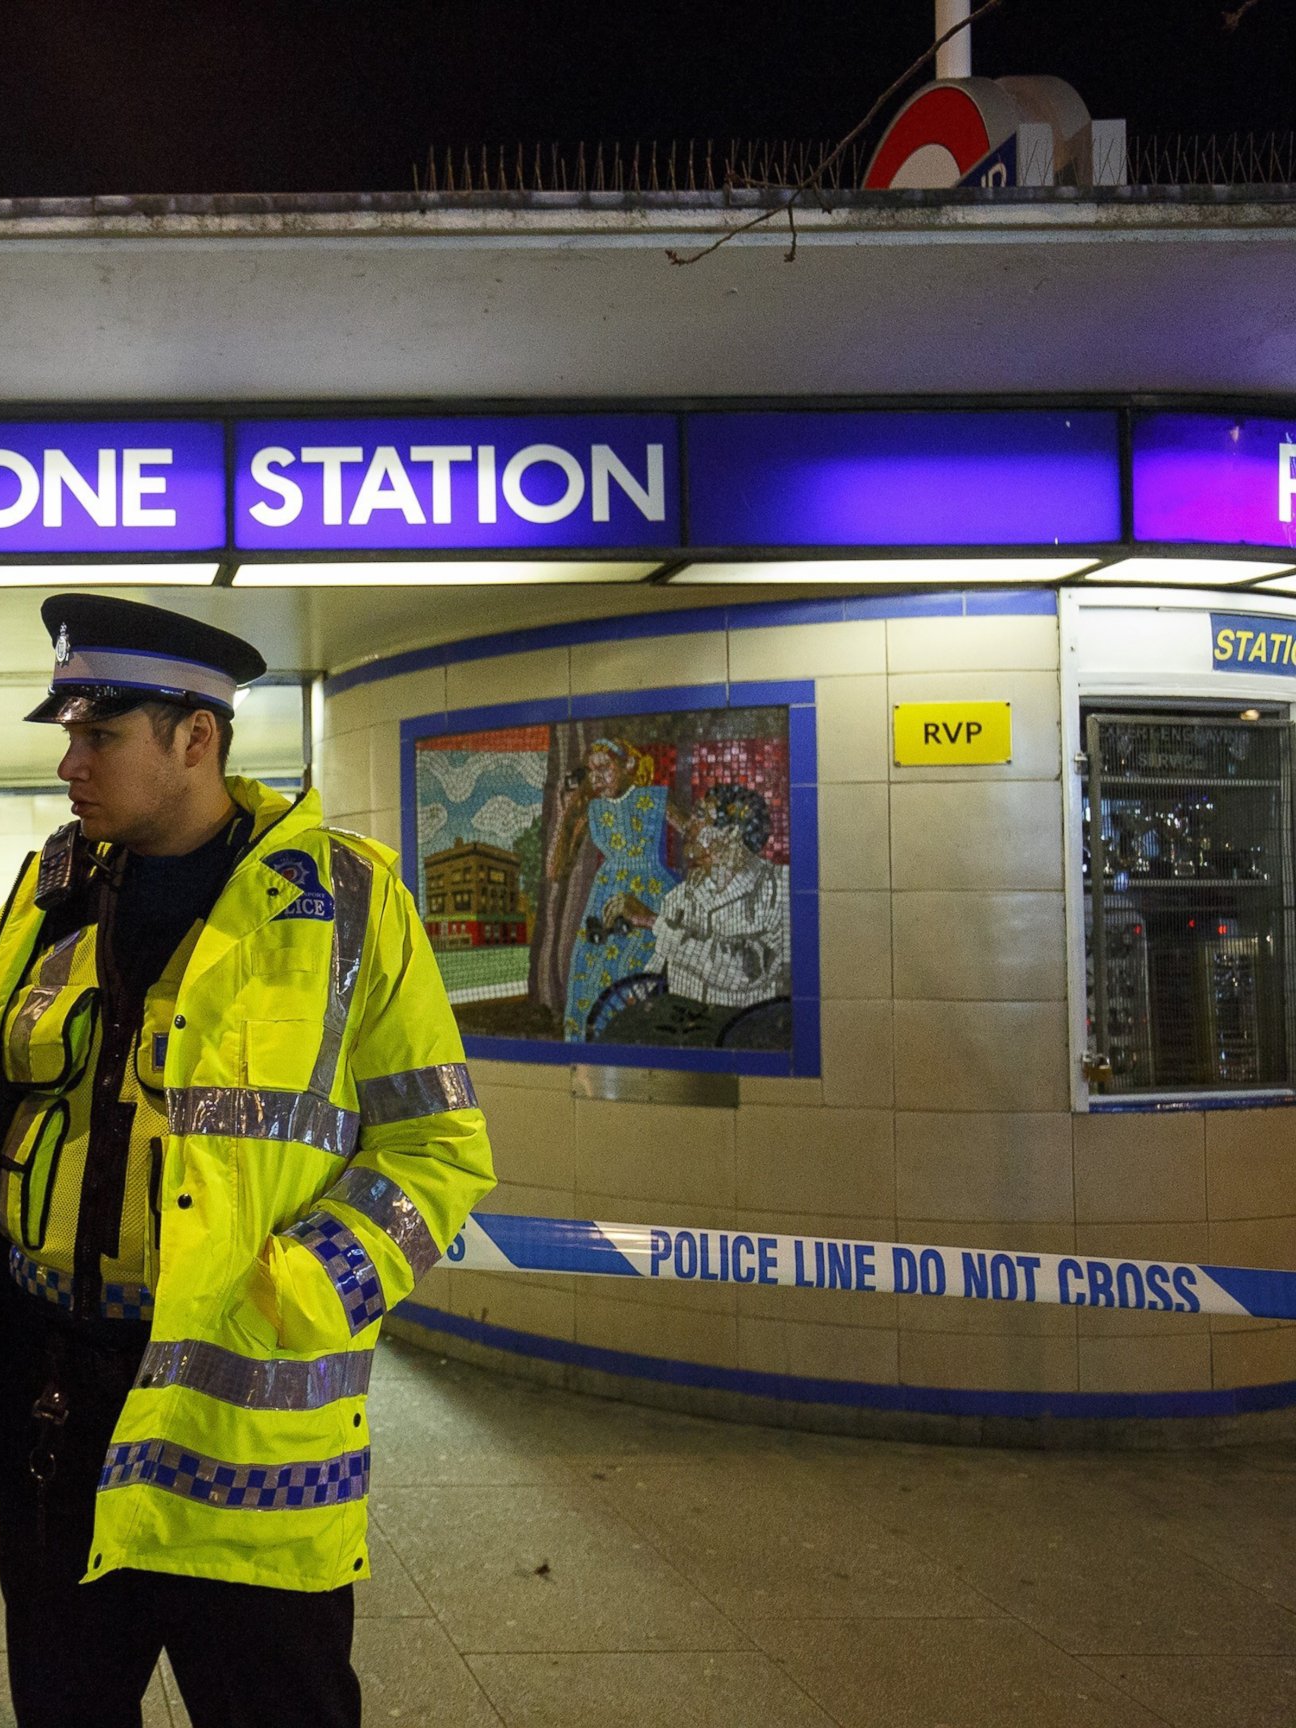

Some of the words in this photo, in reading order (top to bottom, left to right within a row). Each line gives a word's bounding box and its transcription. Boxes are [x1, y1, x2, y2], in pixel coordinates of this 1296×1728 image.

[248, 443, 665, 527] STATION
[1213, 627, 1296, 666] STATI
[923, 721, 983, 744] RVP
[284, 898, 326, 916] LICE
[650, 1228, 779, 1285] POLICE
[794, 1240, 877, 1292] LINE
[892, 1246, 946, 1296] DO
[961, 1251, 1041, 1302] NOT
[1057, 1258, 1200, 1313] CROSS
